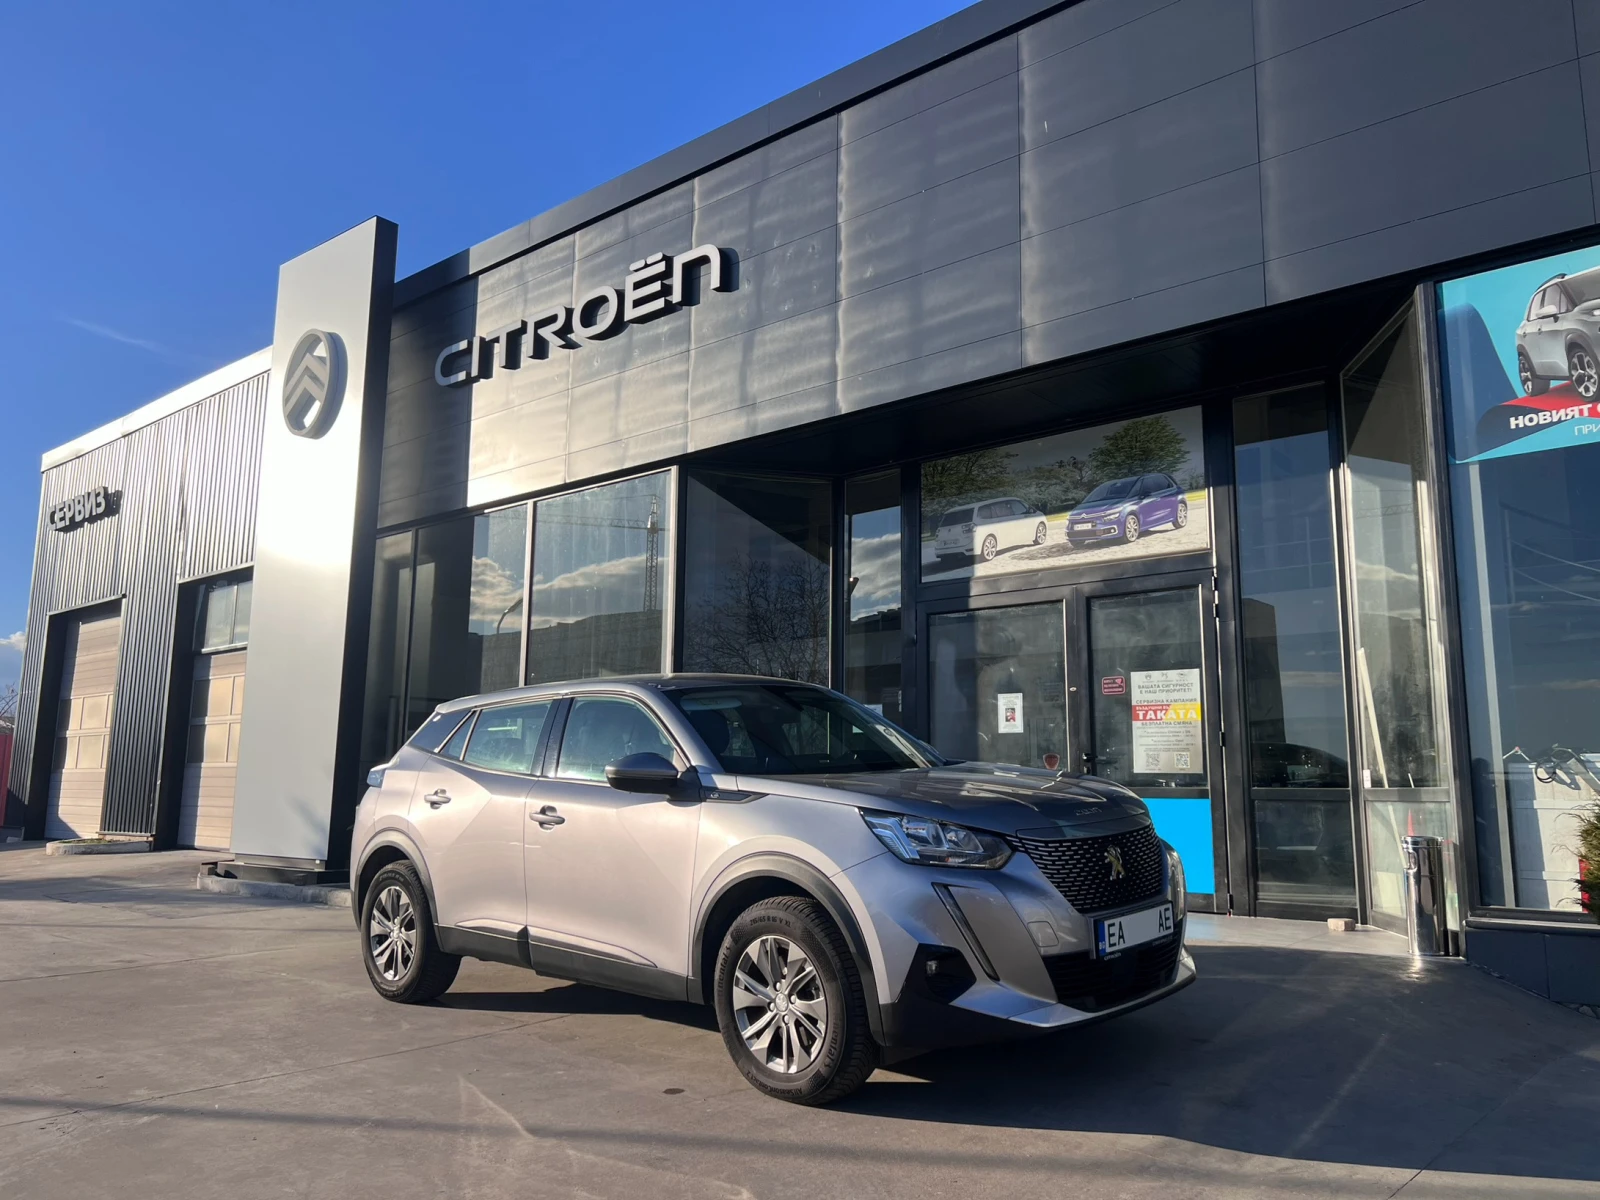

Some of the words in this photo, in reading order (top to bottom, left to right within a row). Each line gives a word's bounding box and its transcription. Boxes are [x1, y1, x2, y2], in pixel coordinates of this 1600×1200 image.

[1509, 403, 1592, 429] НОВИЯТ
[47, 486, 106, 531] СЕРВИЗ
[1107, 921, 1126, 948] EA
[1158, 907, 1172, 933] AE
